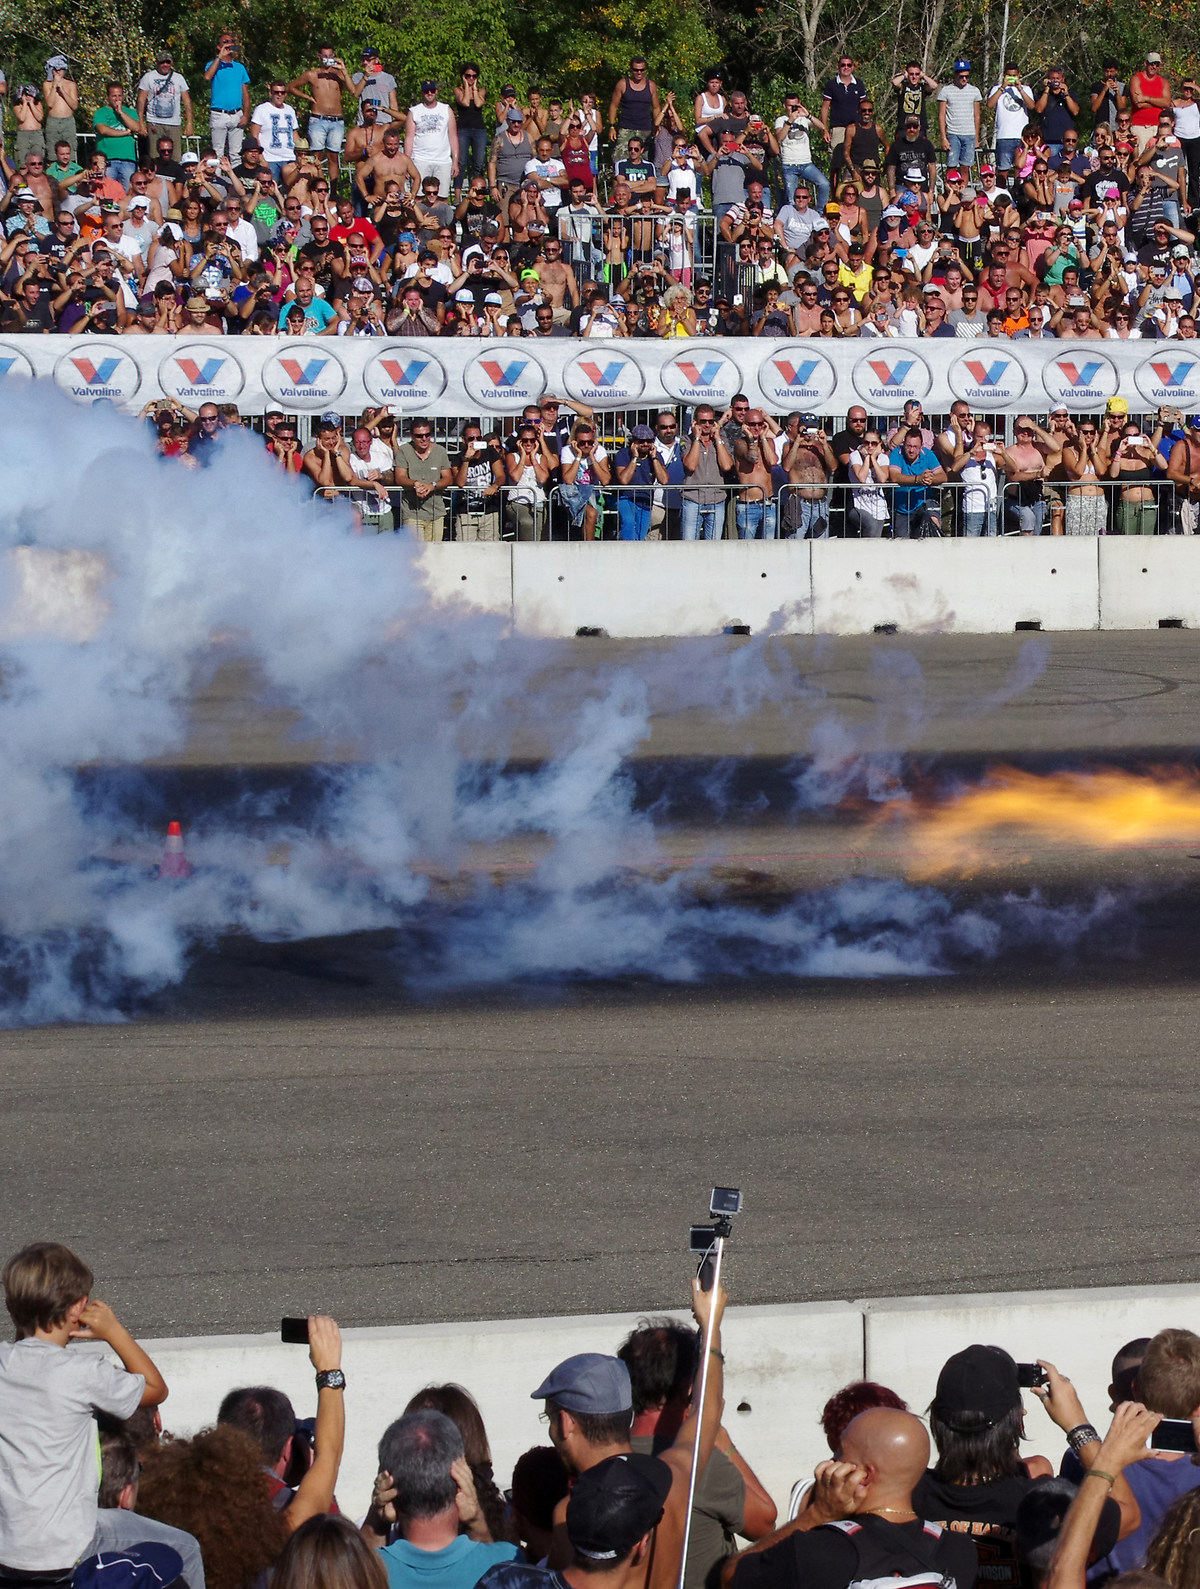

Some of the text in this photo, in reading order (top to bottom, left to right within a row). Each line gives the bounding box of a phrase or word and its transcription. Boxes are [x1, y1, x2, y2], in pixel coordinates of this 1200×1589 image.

[71, 386, 122, 397] Valvoline
[175, 387, 226, 397] Valvoline
[279, 387, 329, 398] Valvoline
[380, 387, 428, 398] Valvoline
[480, 388, 529, 399] Valvoline
[580, 388, 628, 398] Valvoline
[679, 388, 725, 397] Valvoline
[774, 387, 820, 398] Valvoline
[868, 388, 915, 398] Valvoline
[965, 388, 1011, 398] Valvoline
[1059, 388, 1104, 398] Valvoline
[1151, 388, 1196, 398] Valvoline
[950, 1520, 970, 1534] OF
